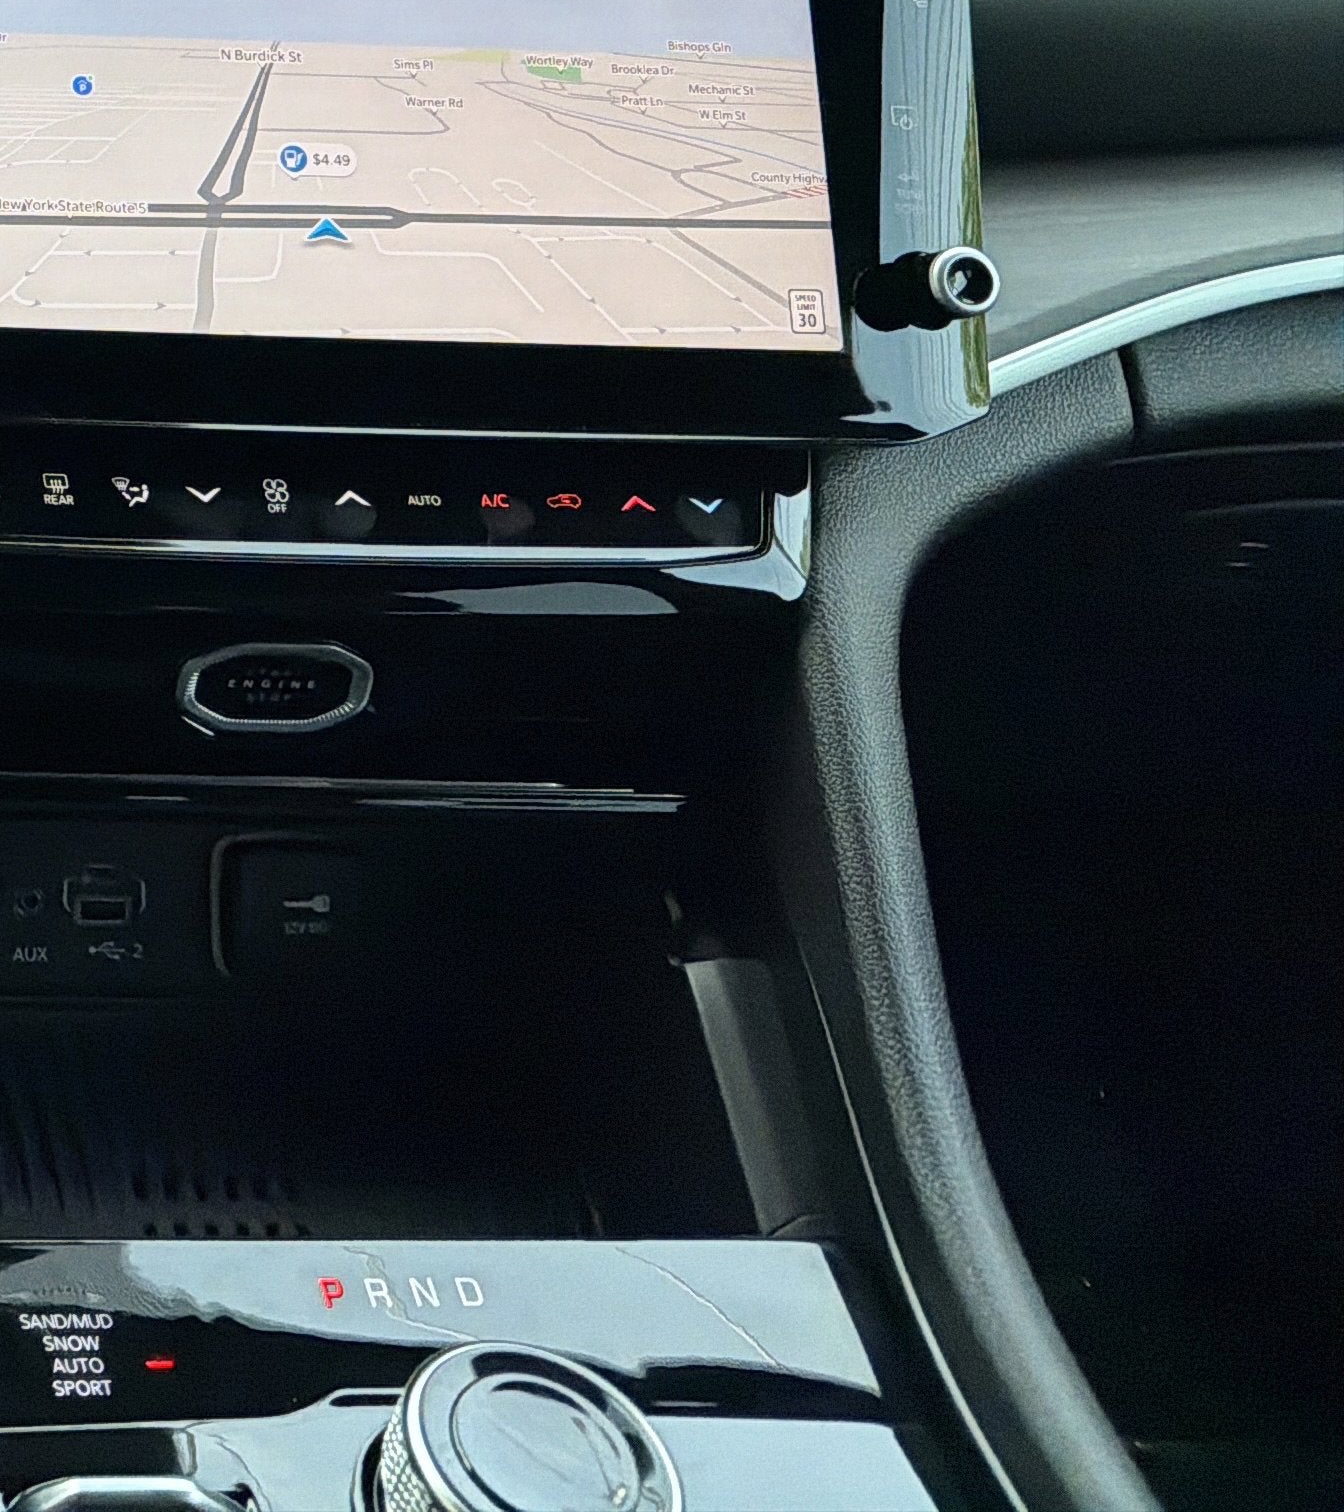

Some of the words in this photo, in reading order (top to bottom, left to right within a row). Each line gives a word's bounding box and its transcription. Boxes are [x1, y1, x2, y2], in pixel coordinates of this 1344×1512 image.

[667, 41, 710, 54] Bishops
[712, 42, 732, 53] Gln
[220, 49, 231, 60] N
[234, 49, 286, 63] Burdick
[288, 51, 302, 63] St
[570, 56, 594, 69] Way
[393, 59, 421, 70] Sims
[611, 64, 660, 76] Brooklea
[661, 65, 674, 76] Dr
[688, 84, 742, 96] Mechanic
[742, 85, 755, 96] St
[405, 96, 446, 109] Warner
[447, 97, 464, 109] Rd
[621, 96, 648, 107] Pratt
[649, 96, 663, 106] Ln
[698, 109, 712, 120] W
[712, 109, 732, 120] Elm
[733, 110, 746, 121] St
[312, 152, 351, 168] $4.49
[751, 172, 792, 185] County
[24, 198, 57, 212] York
[58, 199, 93, 213] State
[95, 201, 135, 214] Route
[138, 202, 147, 214] 5
[798, 313, 817, 328] 30
[42, 494, 75, 506] REAR
[407, 495, 442, 507] AUTO
[480, 493, 511, 508] A/C
[267, 503, 288, 514] OFF
[226, 678, 317, 690] ENGINE
[12, 946, 49, 962] AUX
[132, 943, 144, 959] 2
[317, 1277, 345, 1309] P
[363, 1277, 393, 1308] R
[408, 1277, 441, 1308] N
[454, 1277, 484, 1307] D
[18, 1313, 114, 1330] SAND/MUD
[42, 1335, 100, 1352] SNOW
[52, 1357, 105, 1374] AUTO
[51, 1379, 113, 1397] SPORT
